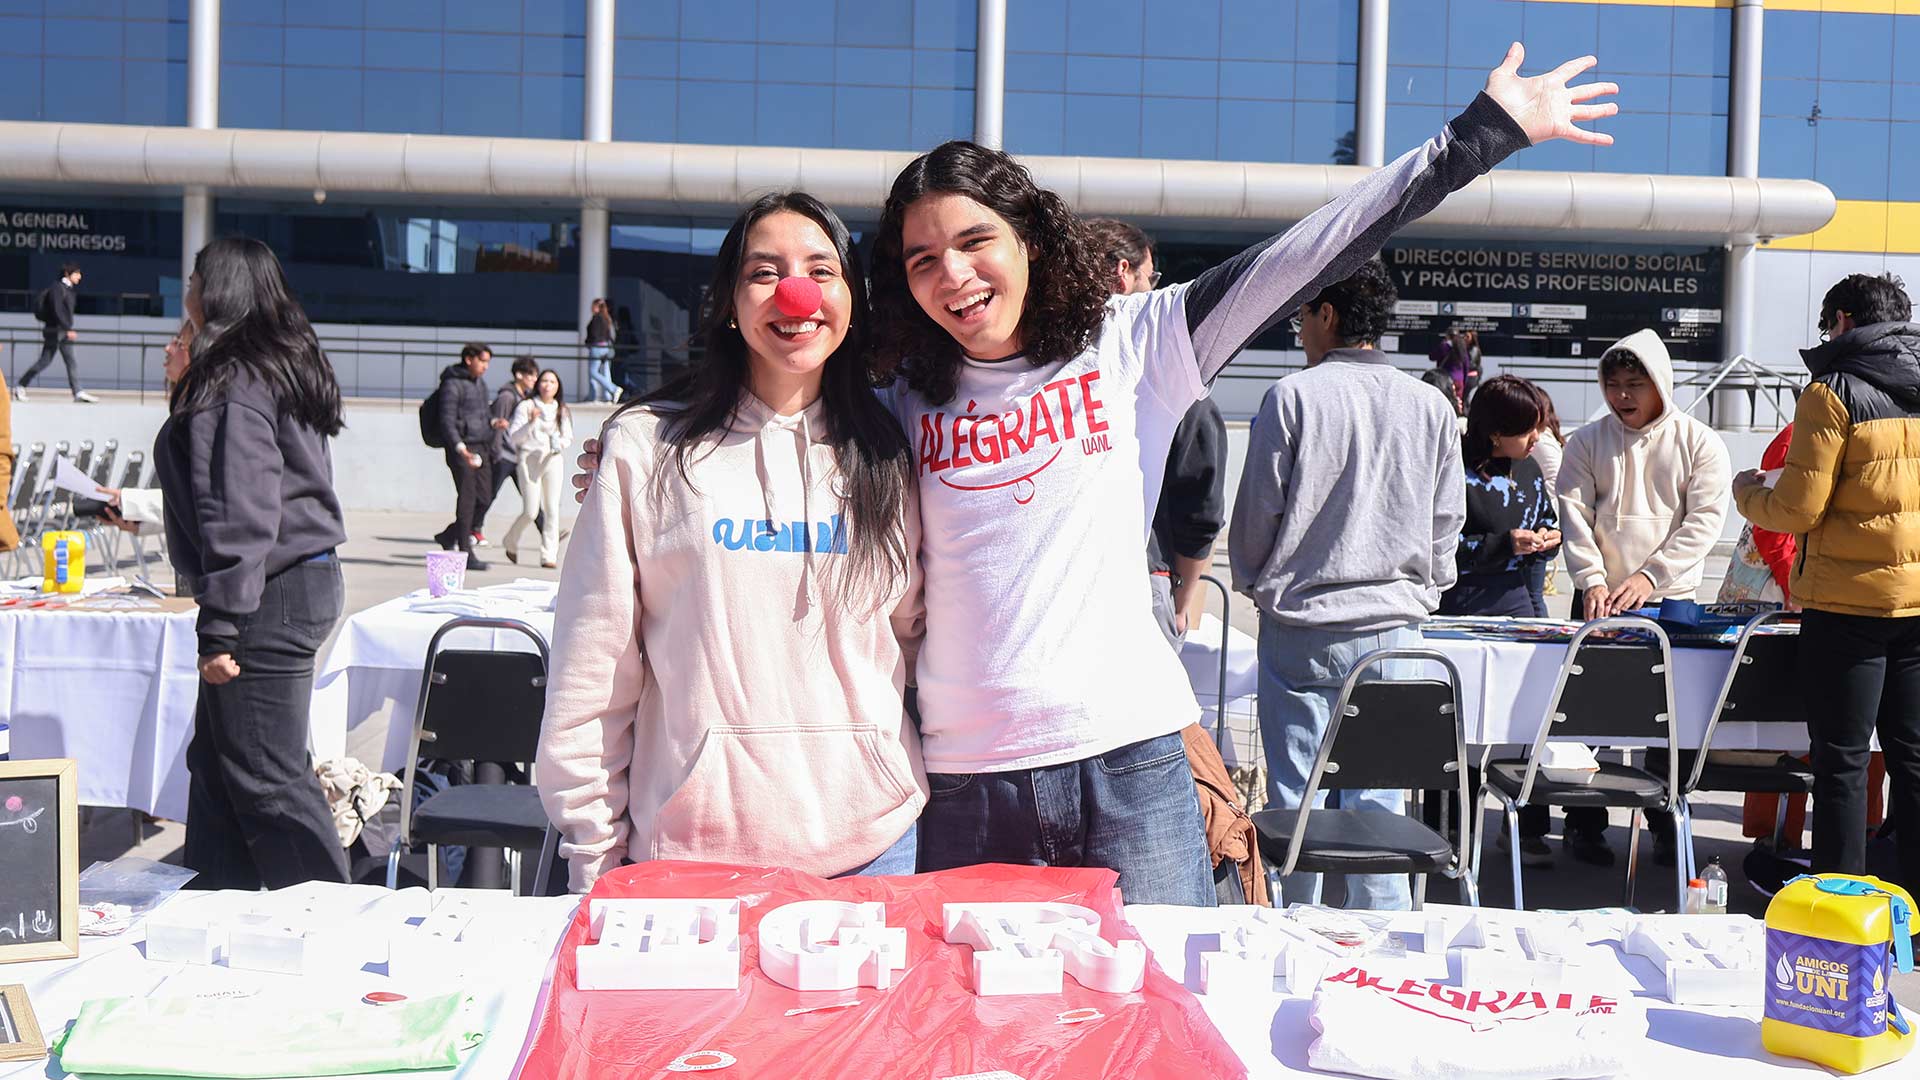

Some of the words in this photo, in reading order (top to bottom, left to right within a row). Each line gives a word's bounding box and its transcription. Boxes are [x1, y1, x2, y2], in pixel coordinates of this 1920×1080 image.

[12, 212, 88, 230] GENERAL
[15, 232, 37, 248] DE
[41, 233, 126, 250] INGRESOS
[1394, 246, 1501, 267] DIRECCIÓN
[1507, 251, 1533, 268] DE
[1538, 252, 1629, 270] SERVICIO
[1635, 255, 1706, 272] SOCIAL
[1401, 270, 1414, 287] Y
[1419, 268, 1530, 289] PRÁCTICAS
[1535, 274, 1699, 294] PROFESIONALES
[919, 369, 1110, 478] ALÉGRATE
[1081, 433, 1113, 456] UANL
[712, 513, 848, 555] uanl
[1797, 956, 1849, 973] AMIGOS
[1796, 972, 1849, 1001] UNI
